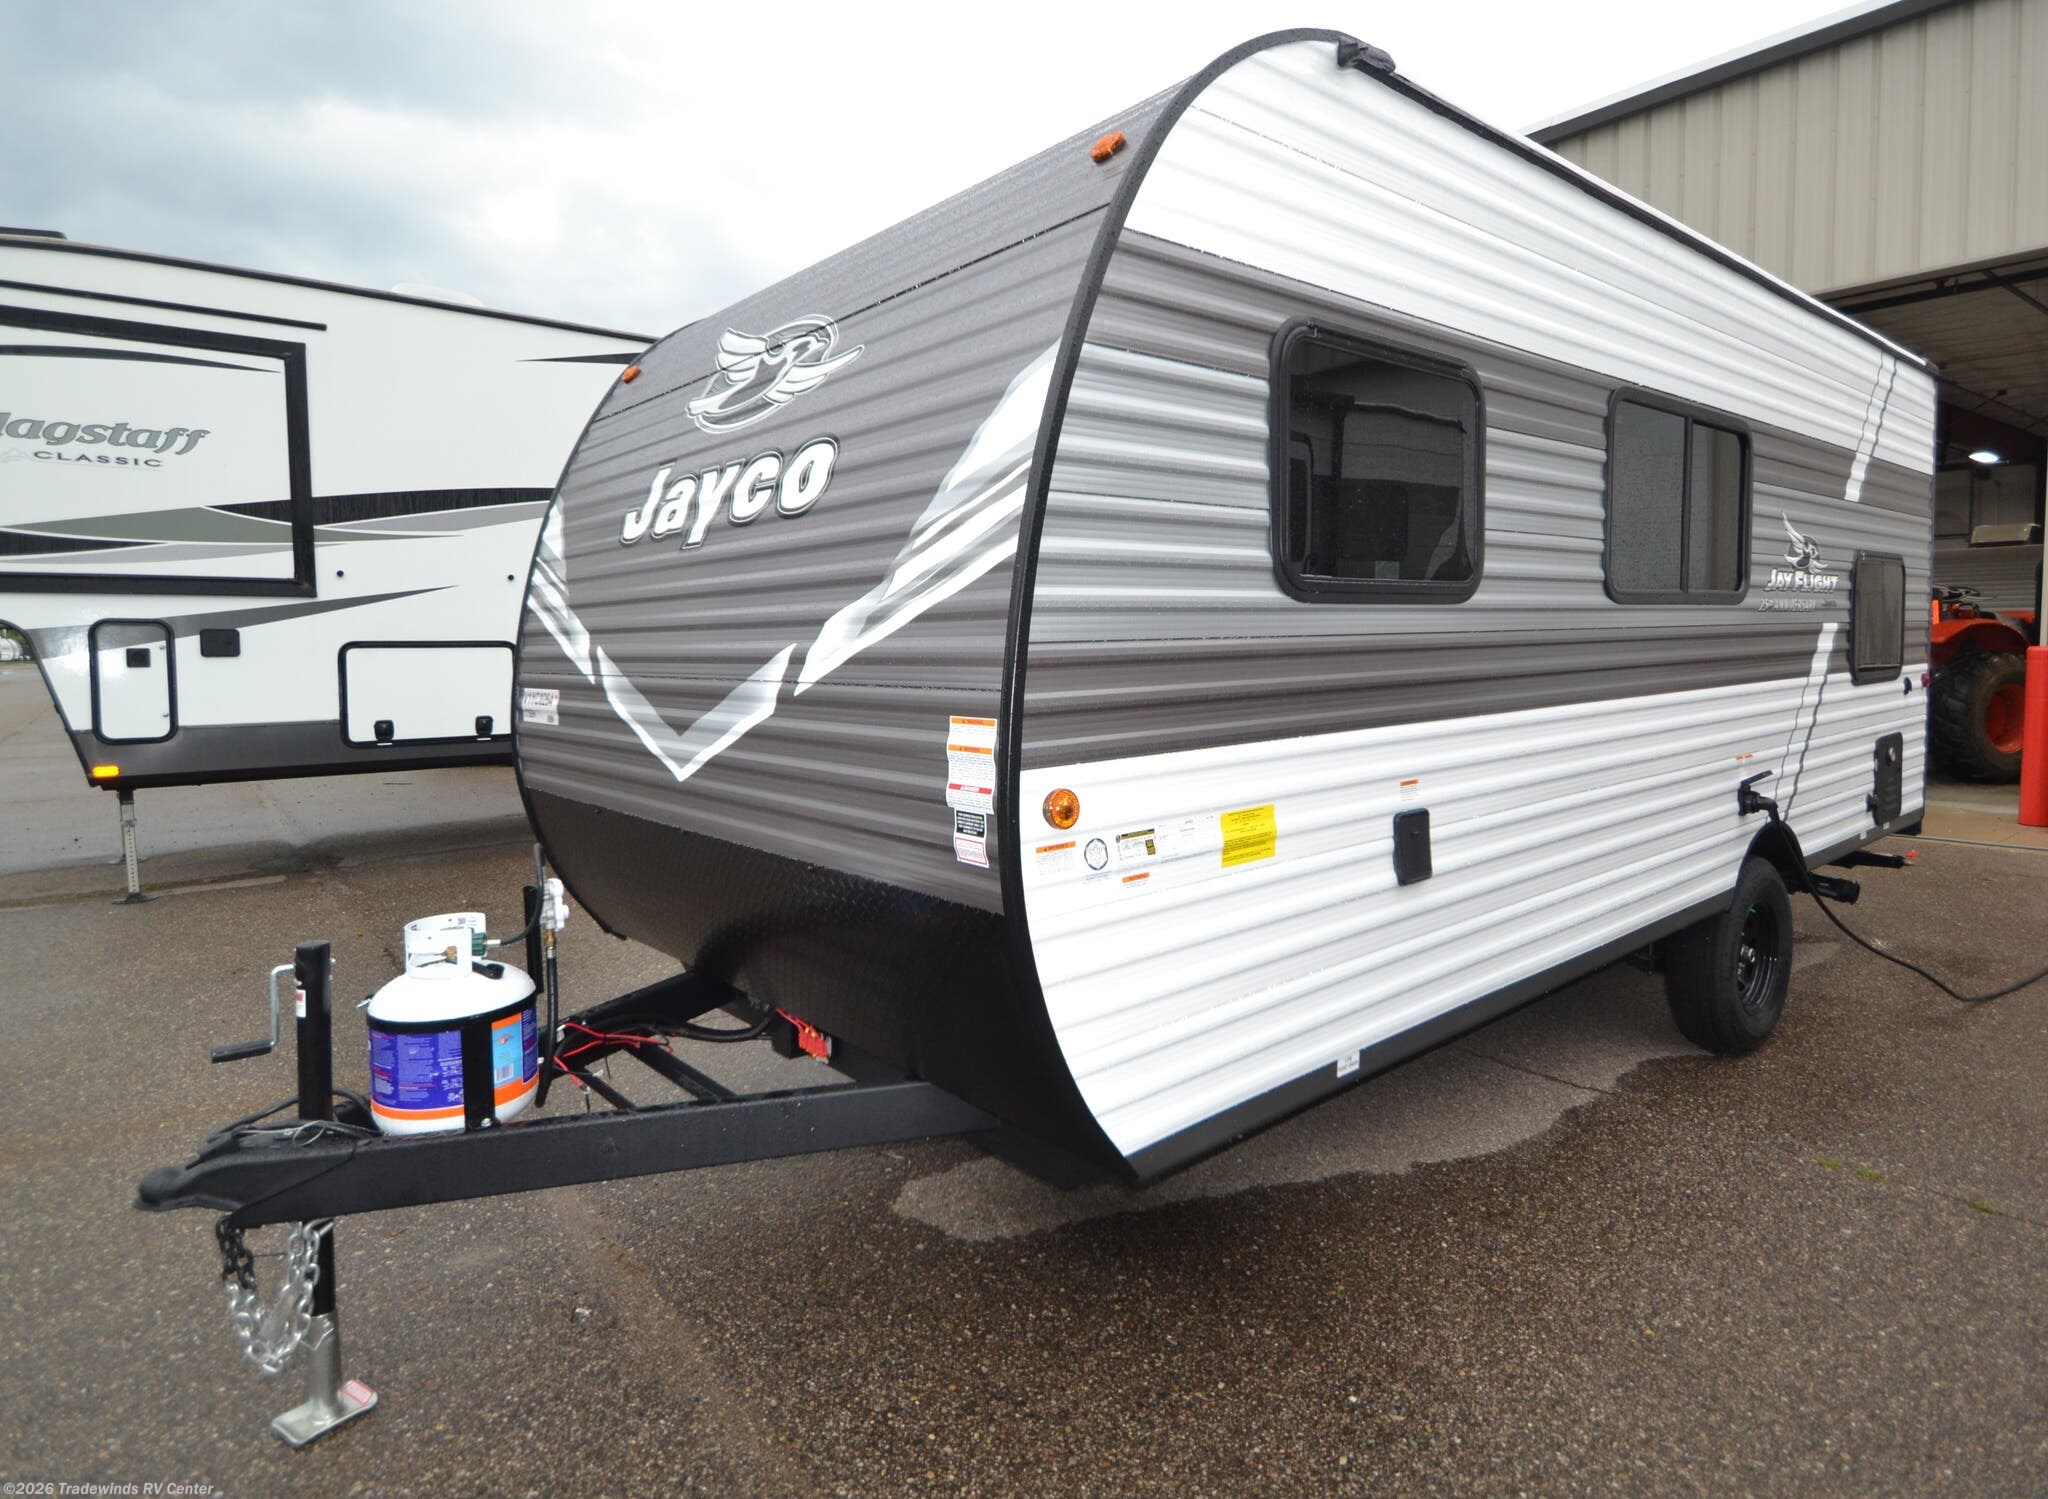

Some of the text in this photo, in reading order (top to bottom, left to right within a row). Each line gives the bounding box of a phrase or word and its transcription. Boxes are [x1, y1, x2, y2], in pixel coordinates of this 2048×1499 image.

[0, 411, 211, 455] lagstaff
[33, 450, 163, 467] CLASSIC
[619, 433, 840, 550] Jayco
[1765, 568, 1838, 593] JAY FLIGHT
